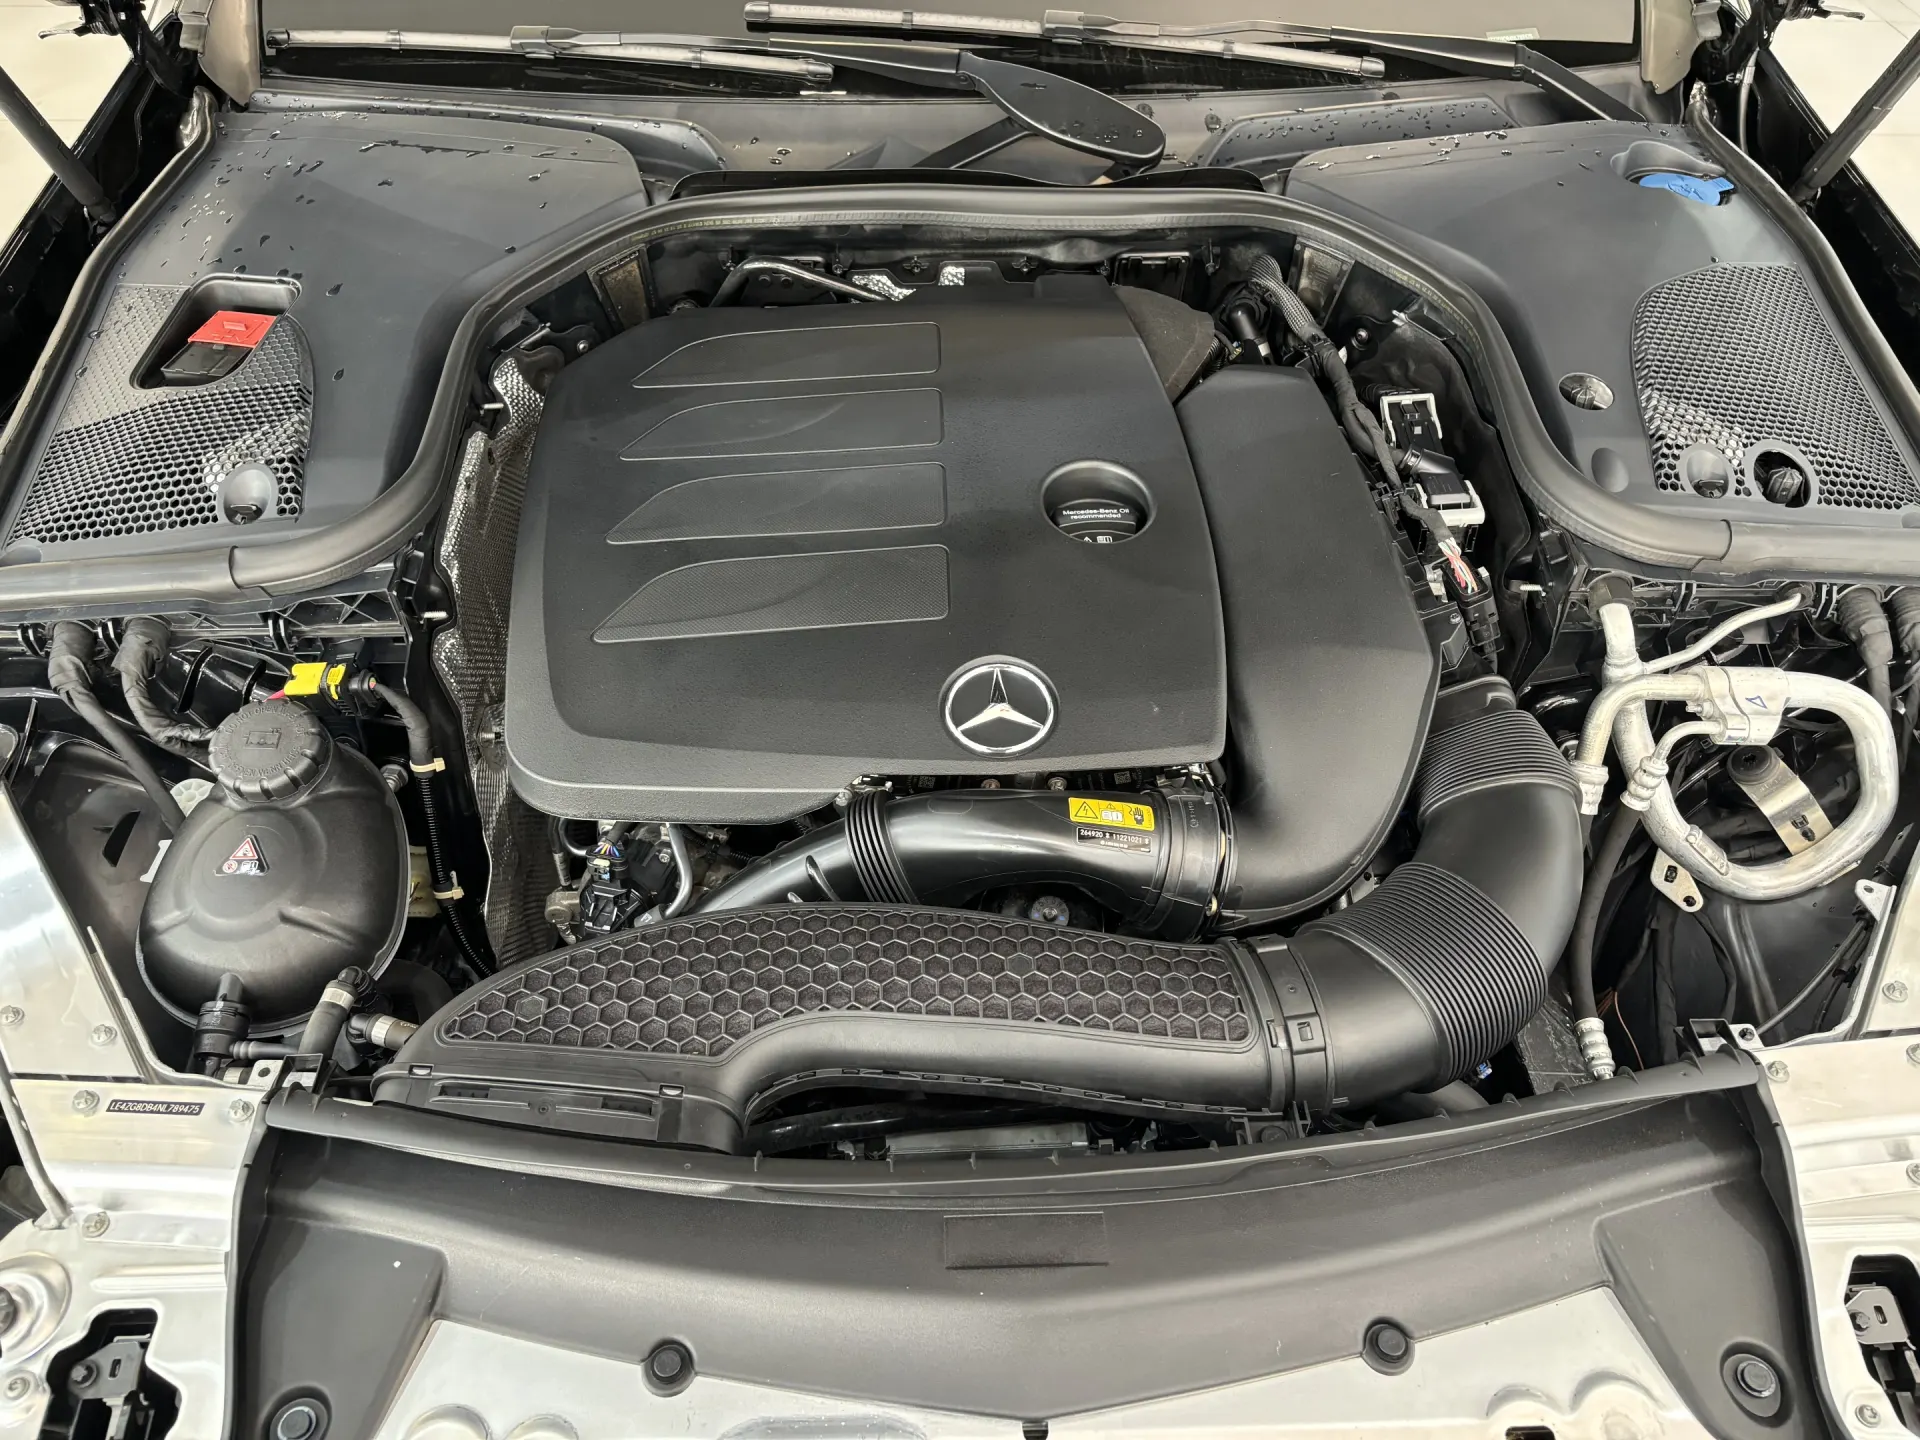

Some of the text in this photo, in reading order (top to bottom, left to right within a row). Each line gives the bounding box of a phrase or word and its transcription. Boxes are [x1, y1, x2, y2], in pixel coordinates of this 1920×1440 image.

[1080, 829, 1103, 838] 264920
[1112, 833, 1142, 844] 11221021
[109, 1101, 200, 1113] LE4ZG8DB4NL789475
